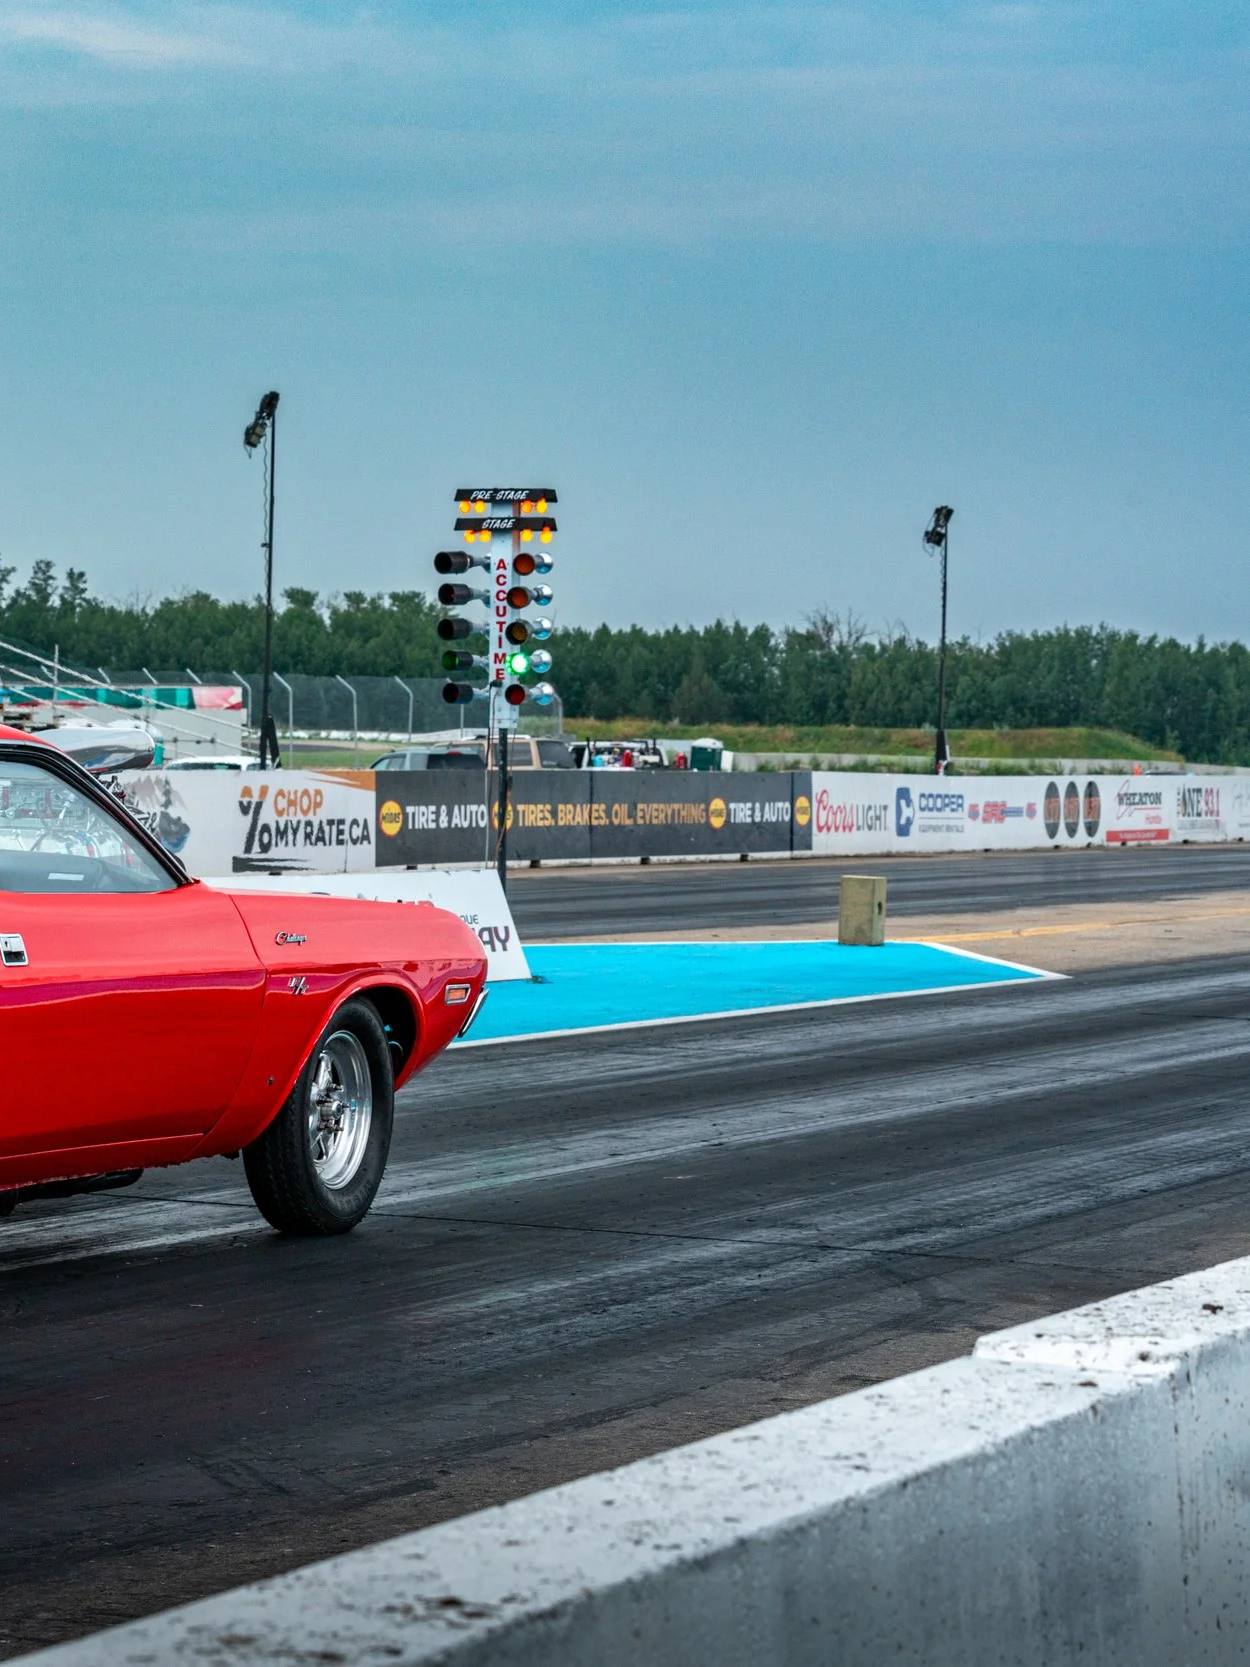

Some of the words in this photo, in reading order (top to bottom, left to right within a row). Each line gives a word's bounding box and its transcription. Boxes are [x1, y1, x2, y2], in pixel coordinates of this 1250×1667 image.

[470, 490, 529, 500] PRE-STAGE
[482, 519, 516, 529] STAGE
[493, 558, 507, 681] ACCUTIME
[273, 788, 324, 817] CHOP
[919, 793, 964, 813] COOPER
[1117, 791, 1162, 806] WHEATON
[406, 804, 437, 829] TIRE
[438, 804, 449, 829] &
[451, 803, 488, 829] AUTO
[516, 803, 555, 827] TIRES.
[557, 803, 610, 827] BRAKES.
[636, 803, 707, 825] EVERYTHING
[729, 802, 752, 824] TIRE
[753, 802, 762, 823] &
[763, 801, 791, 823] AUTO
[815, 788, 855, 834] Coors
[855, 803, 889, 832] LIGHT
[472, 926, 510, 952] AY
